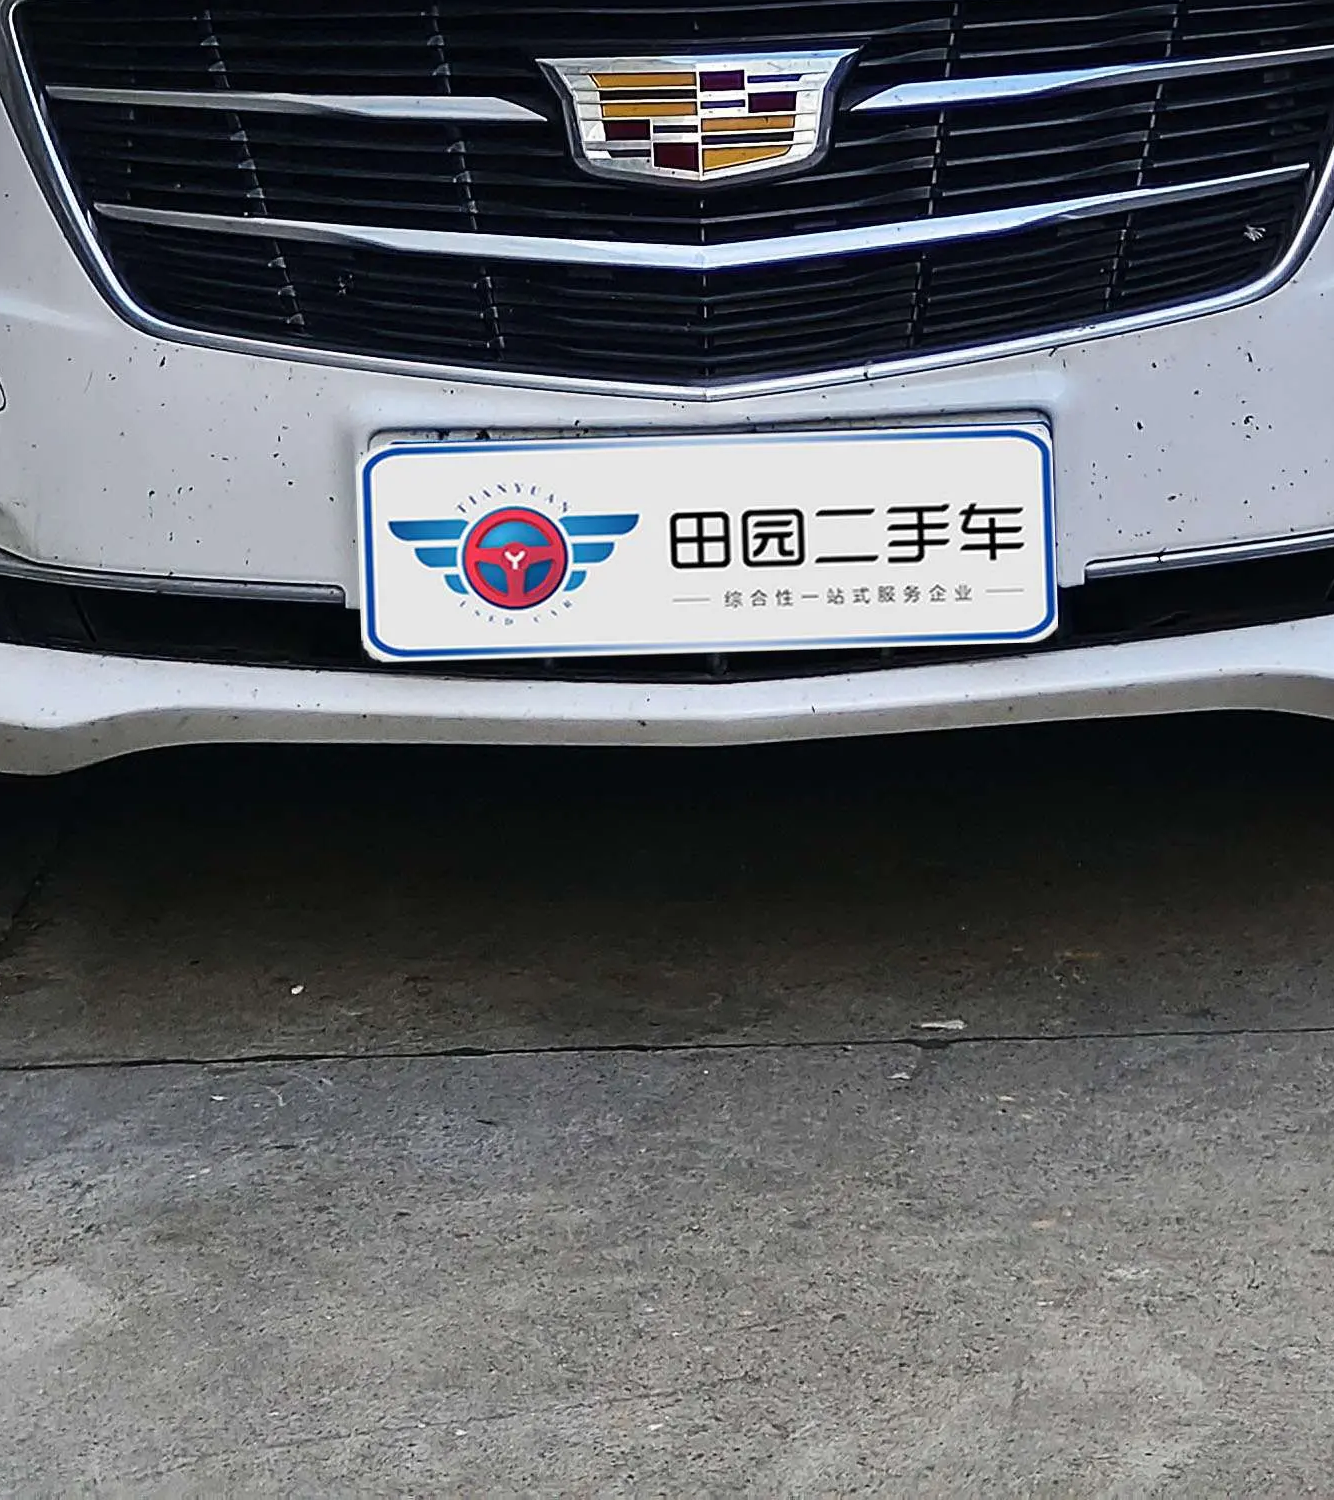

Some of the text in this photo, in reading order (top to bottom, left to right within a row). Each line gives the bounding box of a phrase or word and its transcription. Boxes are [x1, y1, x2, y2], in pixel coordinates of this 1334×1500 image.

[669, 503, 1025, 569] 田园二手车
[723, 584, 973, 608] 综合性一站式服务企业
